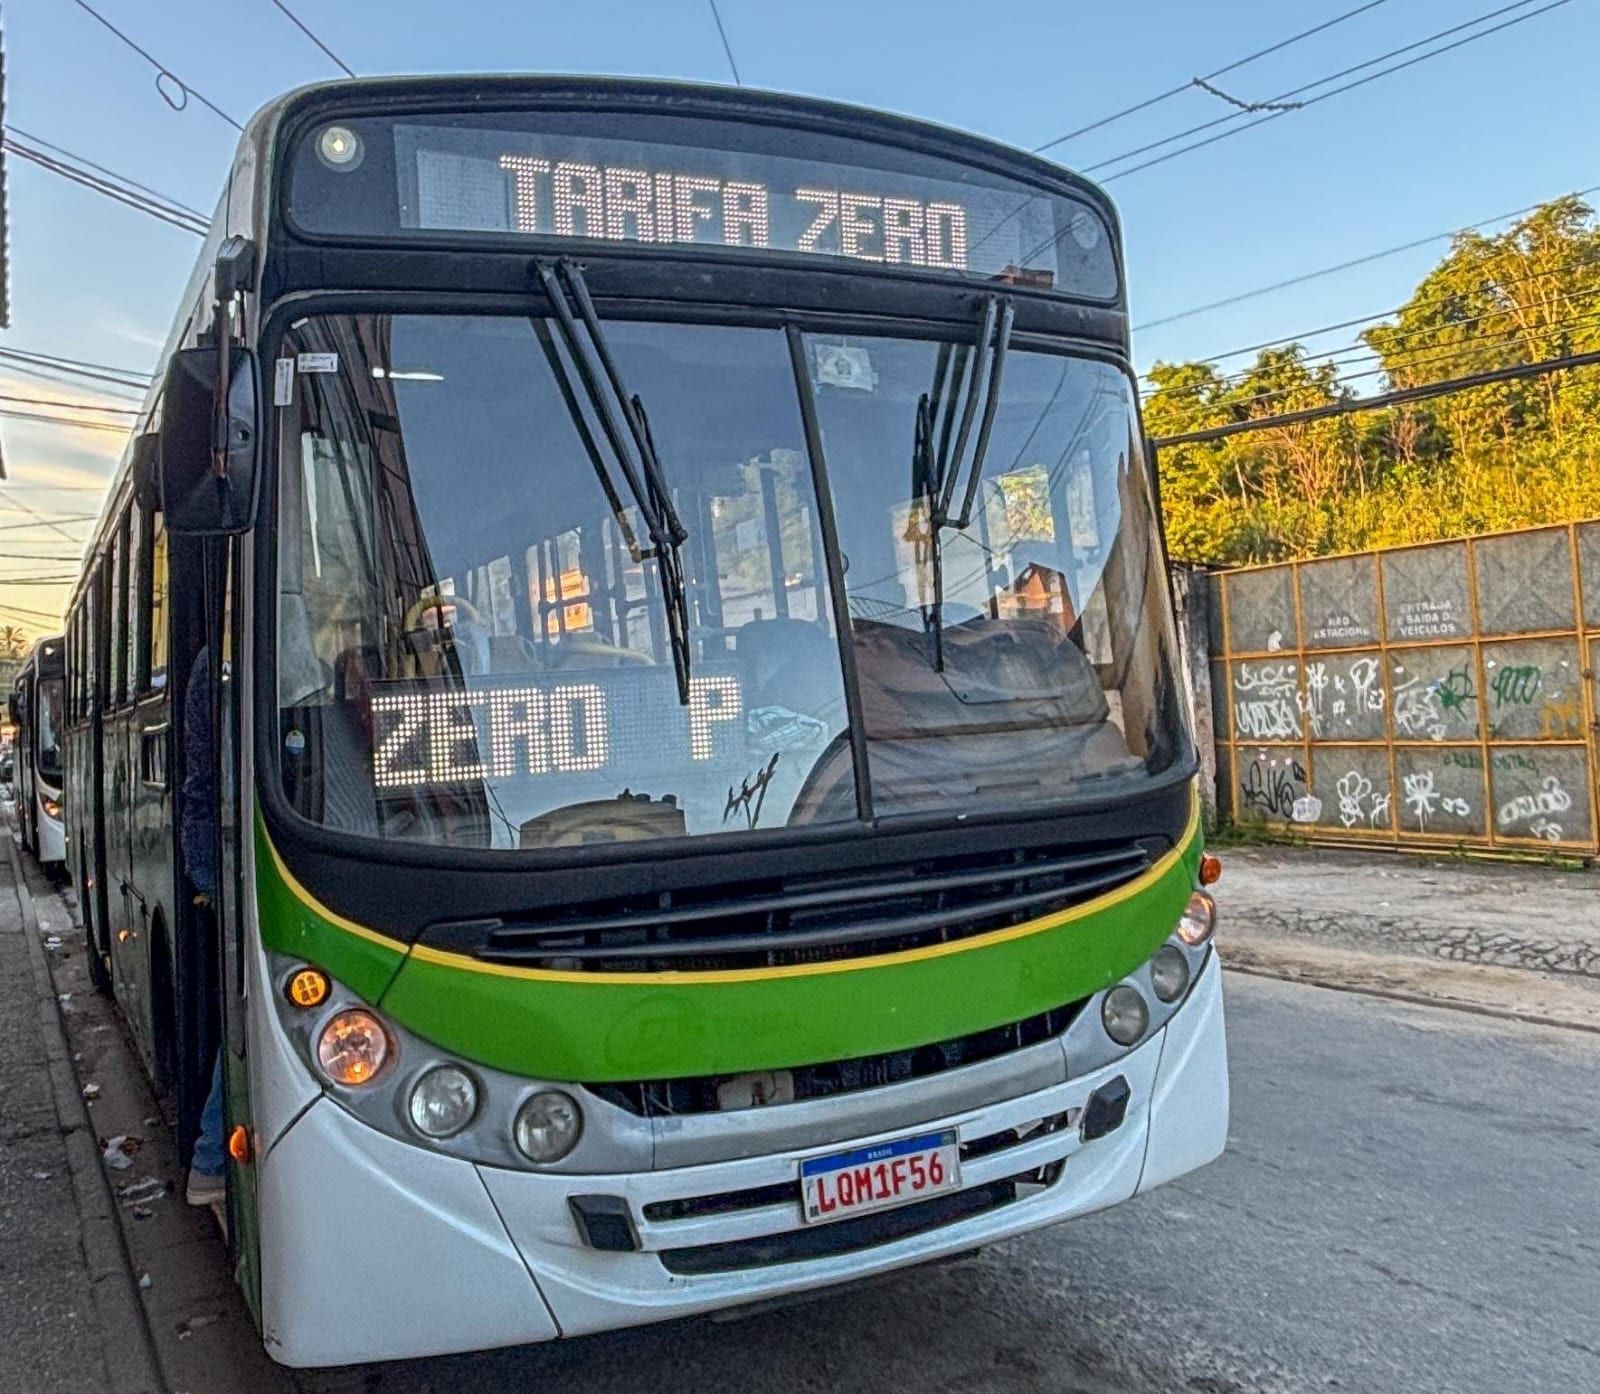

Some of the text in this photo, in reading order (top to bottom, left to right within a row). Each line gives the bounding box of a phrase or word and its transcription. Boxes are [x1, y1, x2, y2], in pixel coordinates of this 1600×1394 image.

[499, 154, 967, 271] TARIFA ZERO
[371, 676, 743, 787] ZERO P
[816, 1151, 944, 1213] LQM1F56
